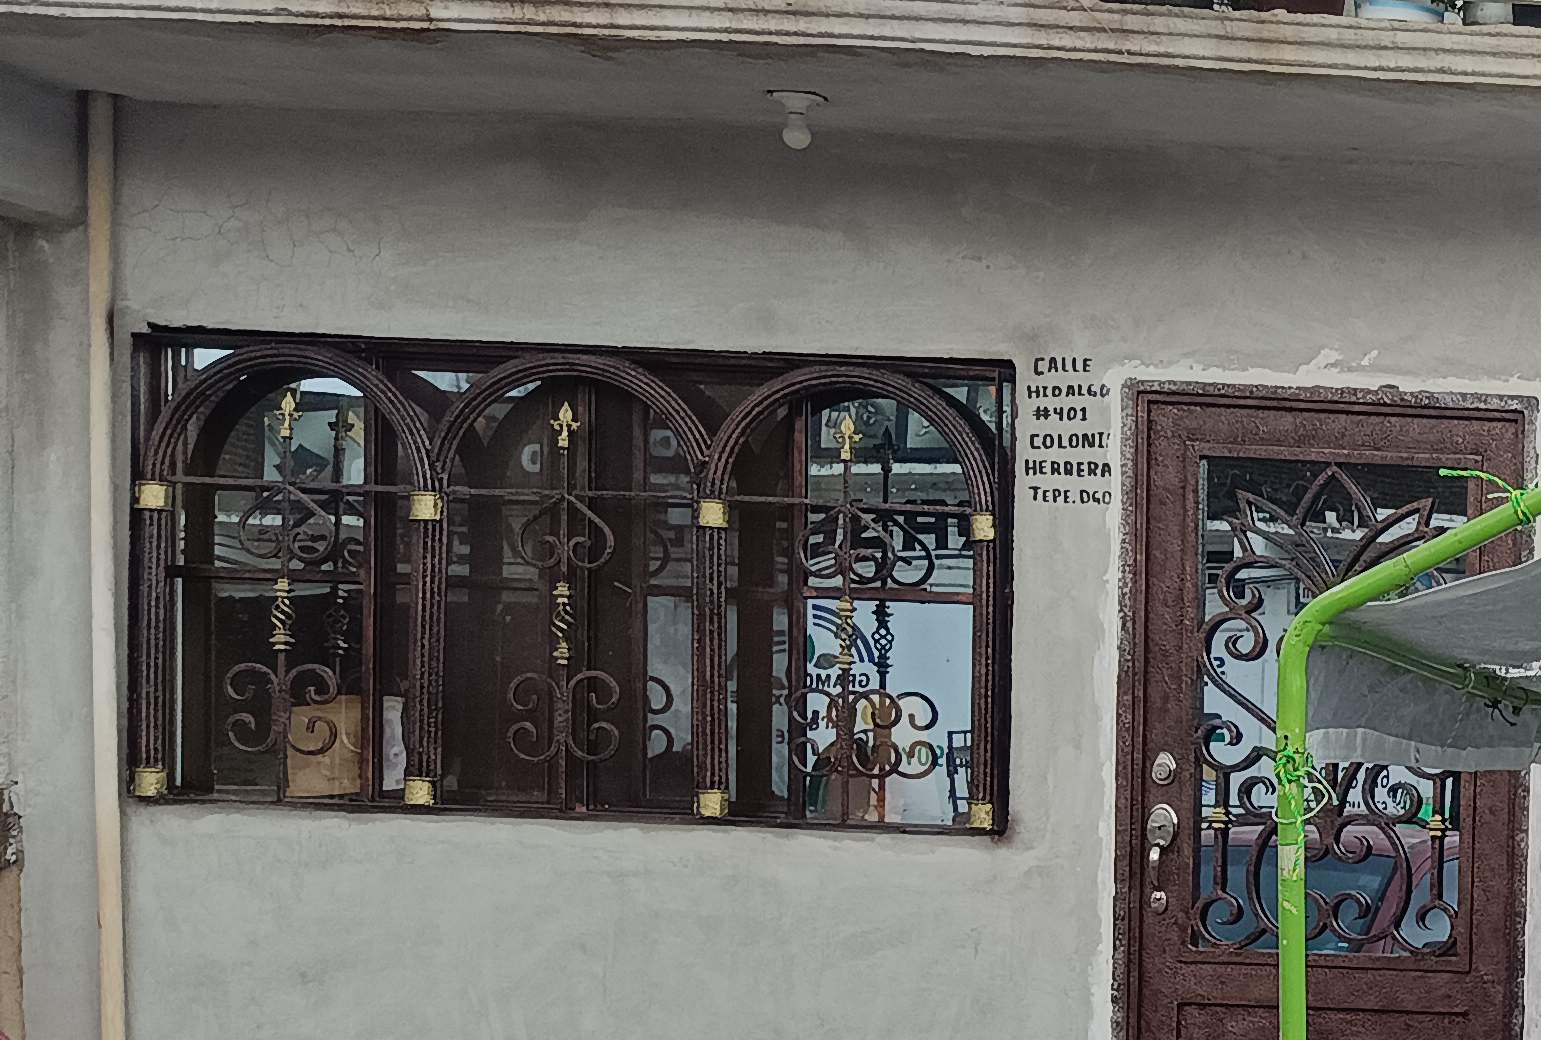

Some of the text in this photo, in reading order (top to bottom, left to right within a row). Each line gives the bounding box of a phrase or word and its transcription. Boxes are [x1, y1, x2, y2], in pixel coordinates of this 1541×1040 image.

[1033, 356, 1093, 376] CALLE
[1026, 383, 1111, 400] HIDALGO
[1031, 406, 1088, 422] #401
[1024, 458, 1112, 478] HERRERA
